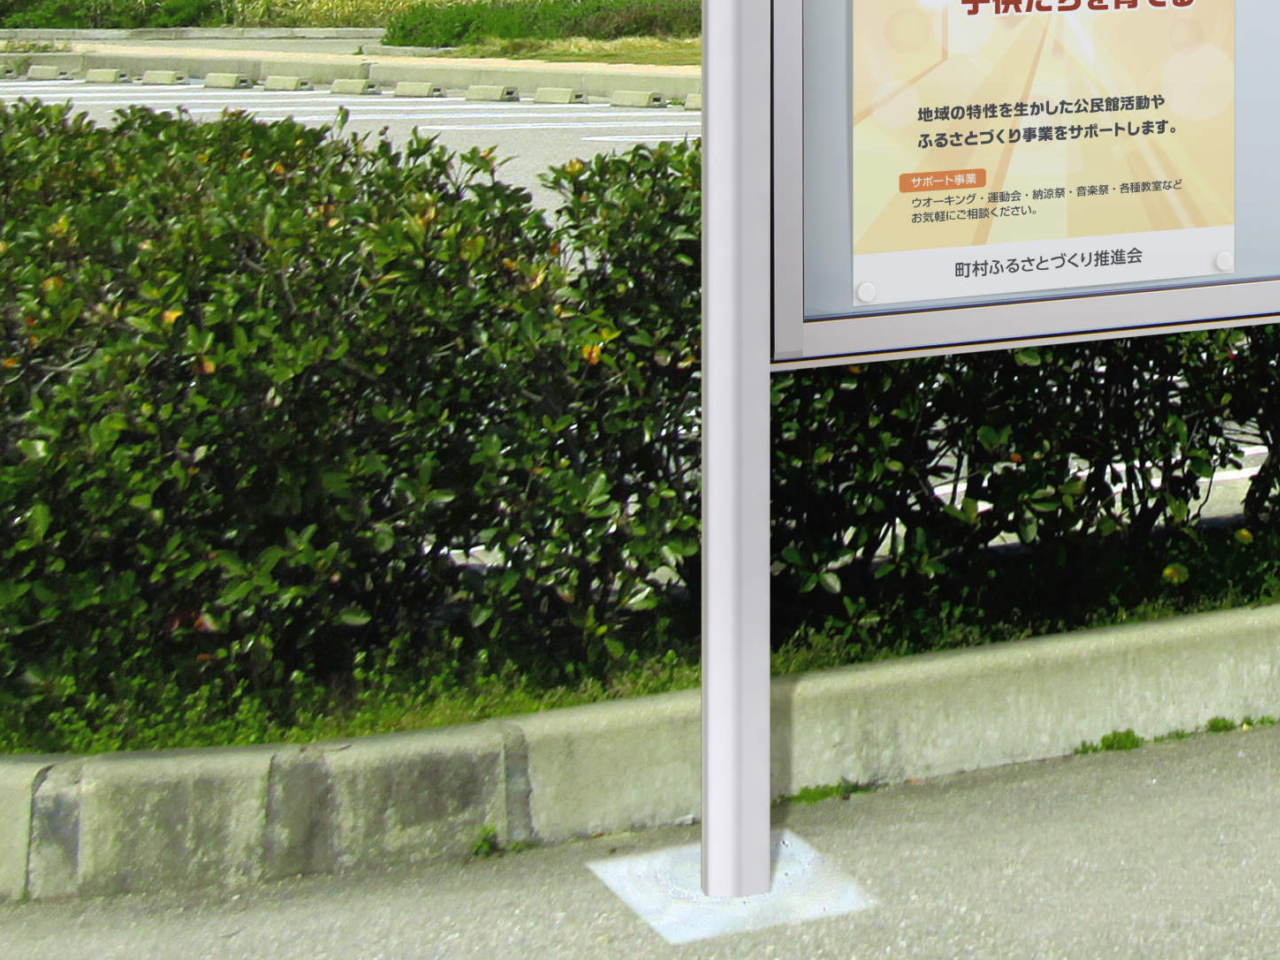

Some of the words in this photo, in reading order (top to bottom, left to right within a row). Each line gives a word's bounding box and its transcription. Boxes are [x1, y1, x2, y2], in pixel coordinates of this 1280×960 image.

[917, 94, 1165, 122] 地域の特性を生かした公民館活動や
[917, 119, 1176, 149] ふるさとづくり事業をサポートします。
[910, 173, 977, 188] サポート事業
[911, 204, 1037, 224] お気軽にご相談ください。
[955, 247, 1143, 279] 町村ふるさとづくり推進会
